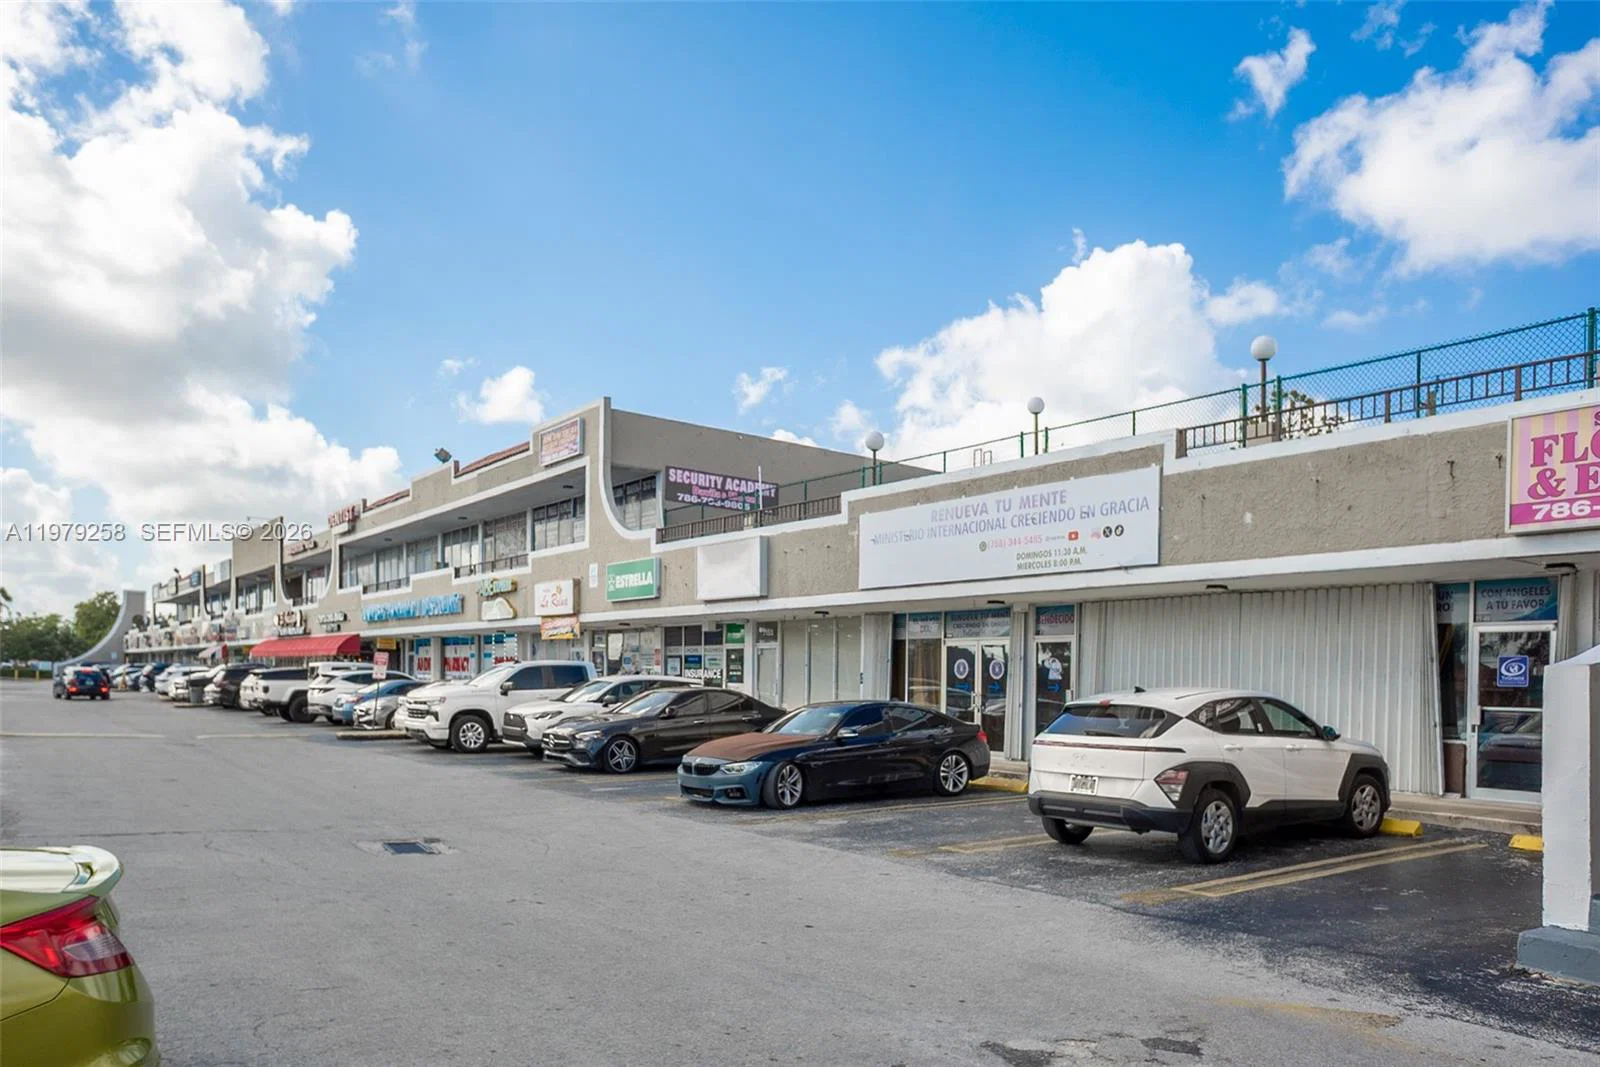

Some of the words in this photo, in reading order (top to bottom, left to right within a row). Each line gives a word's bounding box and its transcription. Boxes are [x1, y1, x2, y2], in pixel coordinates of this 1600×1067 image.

[668, 468, 723, 490] SECURITY
[1528, 468, 1566, 500] &
[931, 502, 989, 523] RENUEVA
[995, 497, 1012, 513] TU
[1019, 489, 1067, 510] MENTE
[873, 528, 924, 545] MINISTERIO
[927, 516, 1007, 539] INTERNACIONAL
[1011, 507, 1075, 529] CRECIENDO
[1080, 503, 1096, 520] EN
[1100, 496, 1150, 517] GRACIA
[1016, 550, 1052, 561] DOMINGOS
[615, 571, 653, 588] ESTRELLA
[1481, 588, 1502, 598] CON
[1504, 586, 1550, 597] ANGELES
[1486, 602, 1494, 610] A
[1495, 602, 1508, 610] TU
[1511, 600, 1545, 610] FAVOR
[684, 667, 722, 679] INSURANCE
